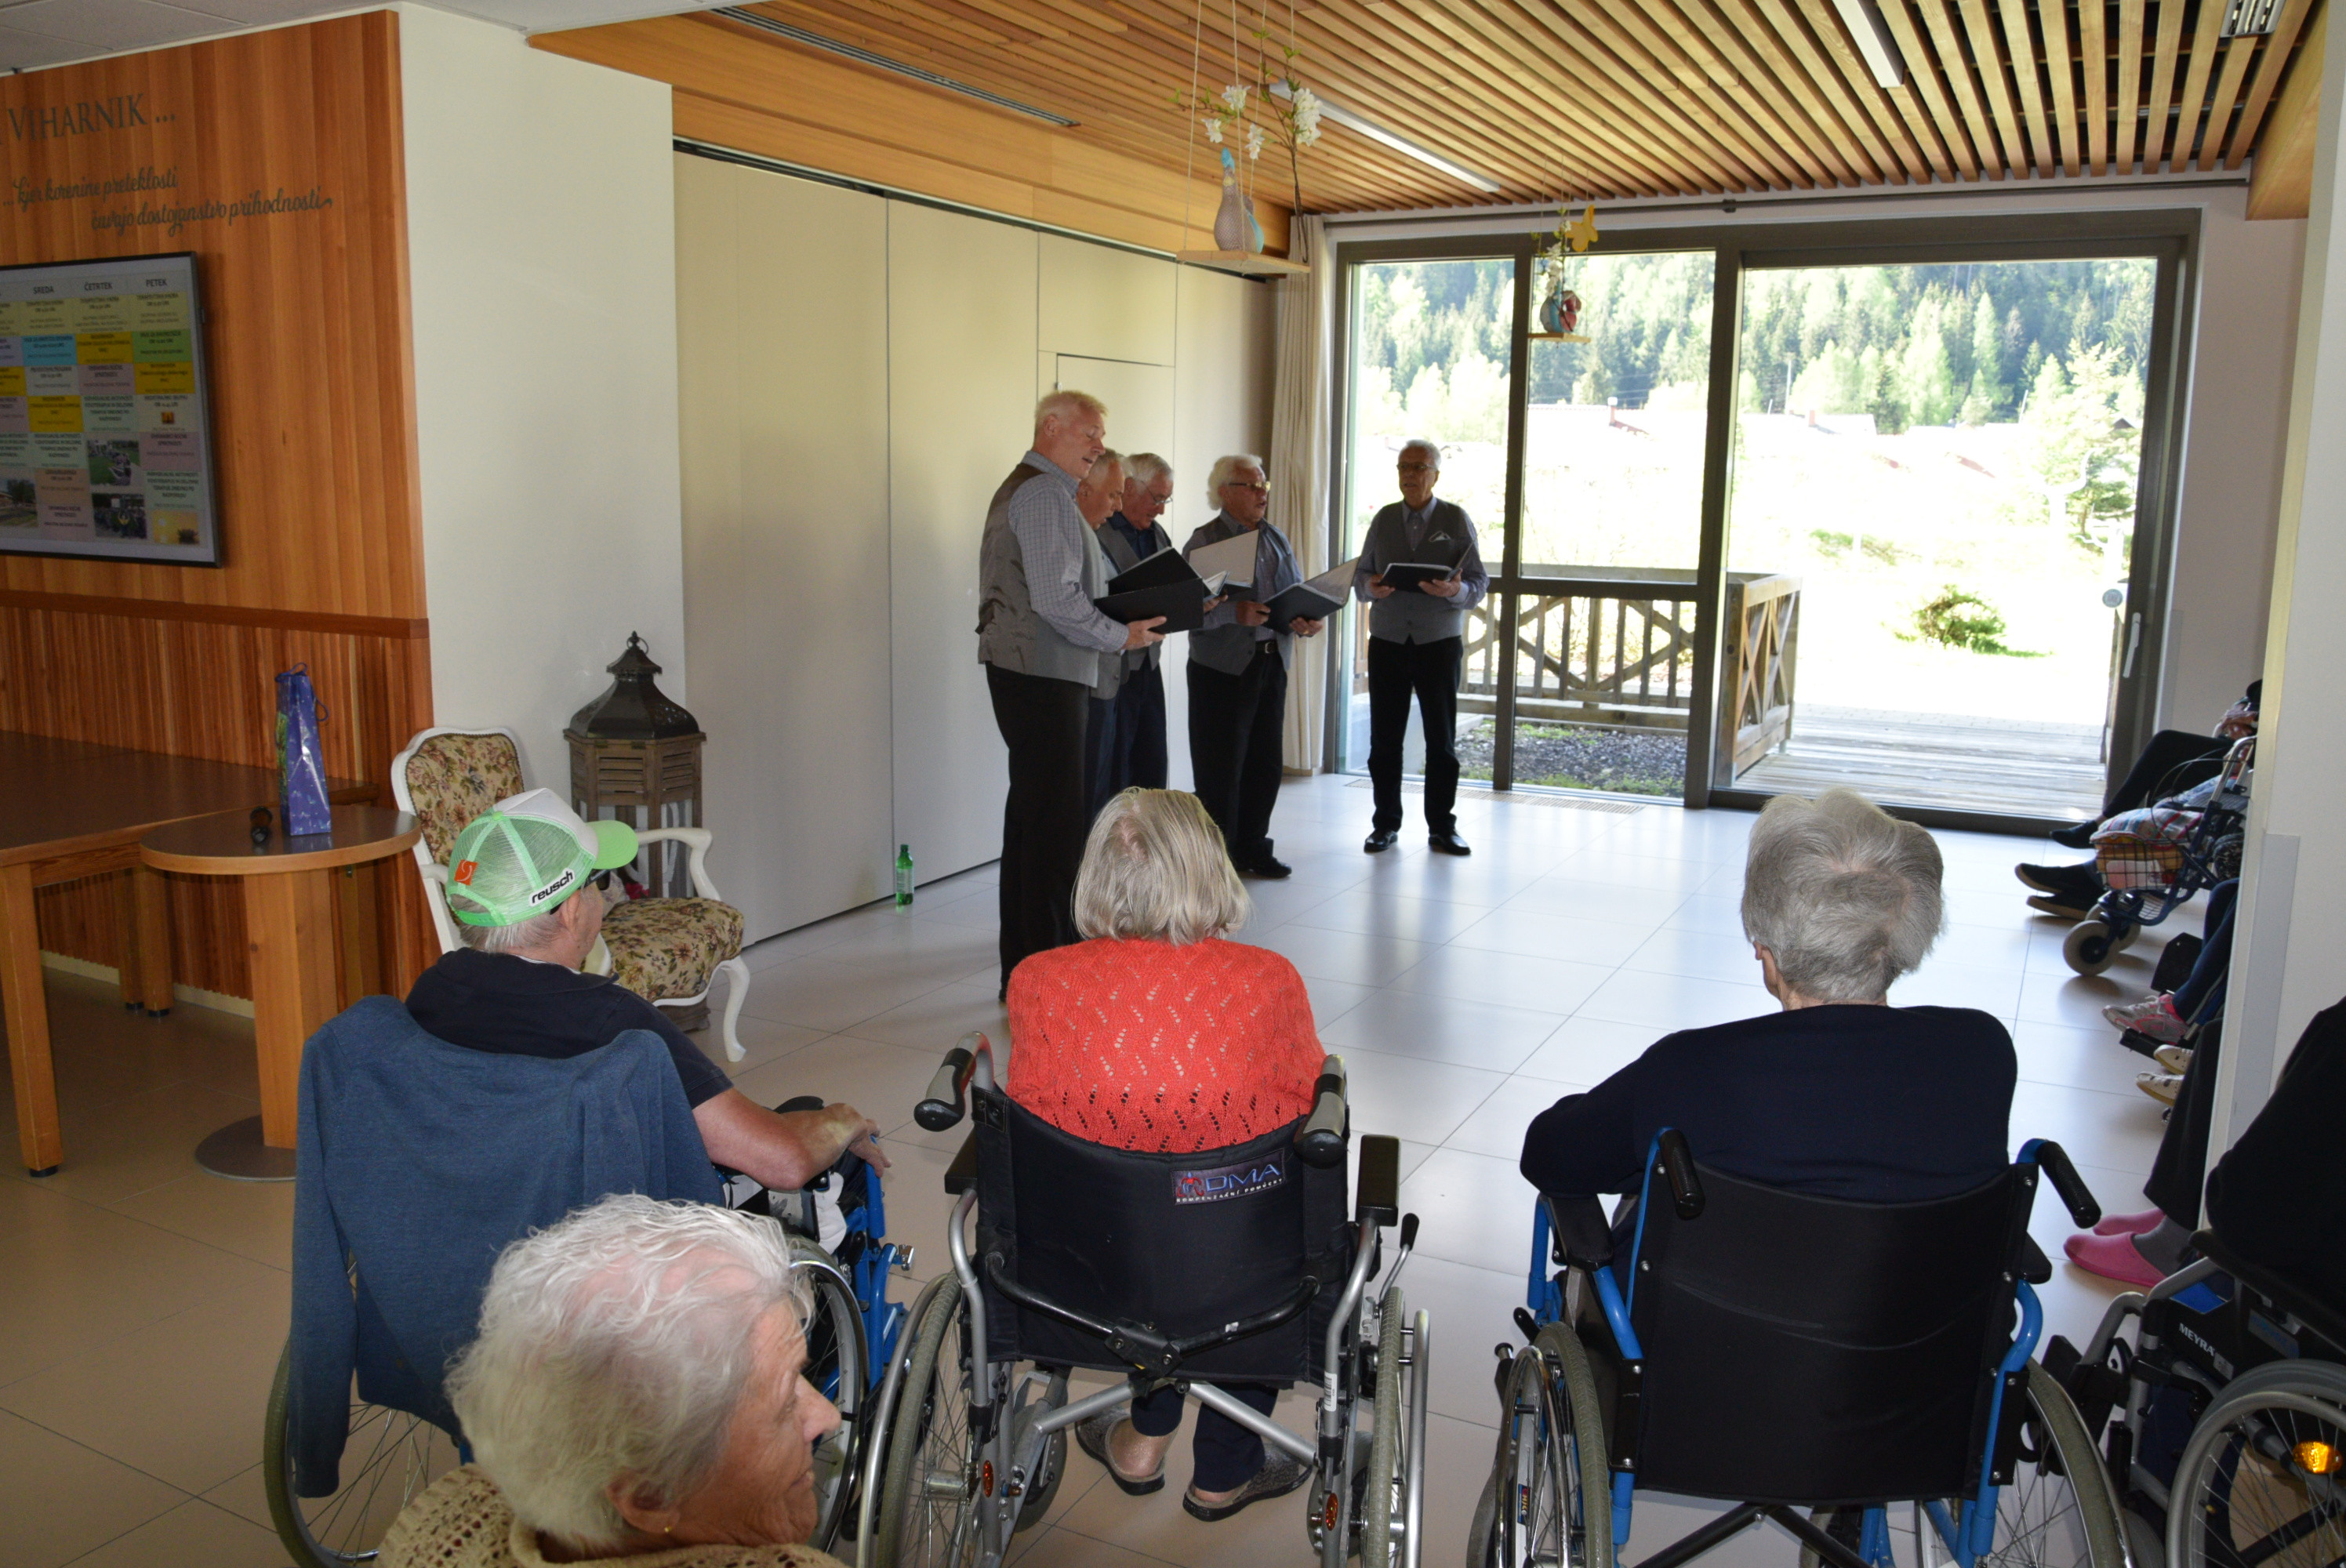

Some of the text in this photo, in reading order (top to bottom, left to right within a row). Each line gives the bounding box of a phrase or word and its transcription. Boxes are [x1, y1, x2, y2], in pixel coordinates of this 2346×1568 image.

[8, 93, 147, 141] VIHARNIK
[45, 176, 100, 201] korenine
[104, 165, 179, 202] preteklosti
[136, 198, 227, 237] dostojanstvo
[229, 185, 333, 227] prihodnosti
[33, 278, 168, 295] SREDA ČETRTEK PETEK
[532, 871, 573, 903] reusch
[1206, 1164, 1280, 1192] DMA
[2178, 1323, 2214, 1356] MEYRA
